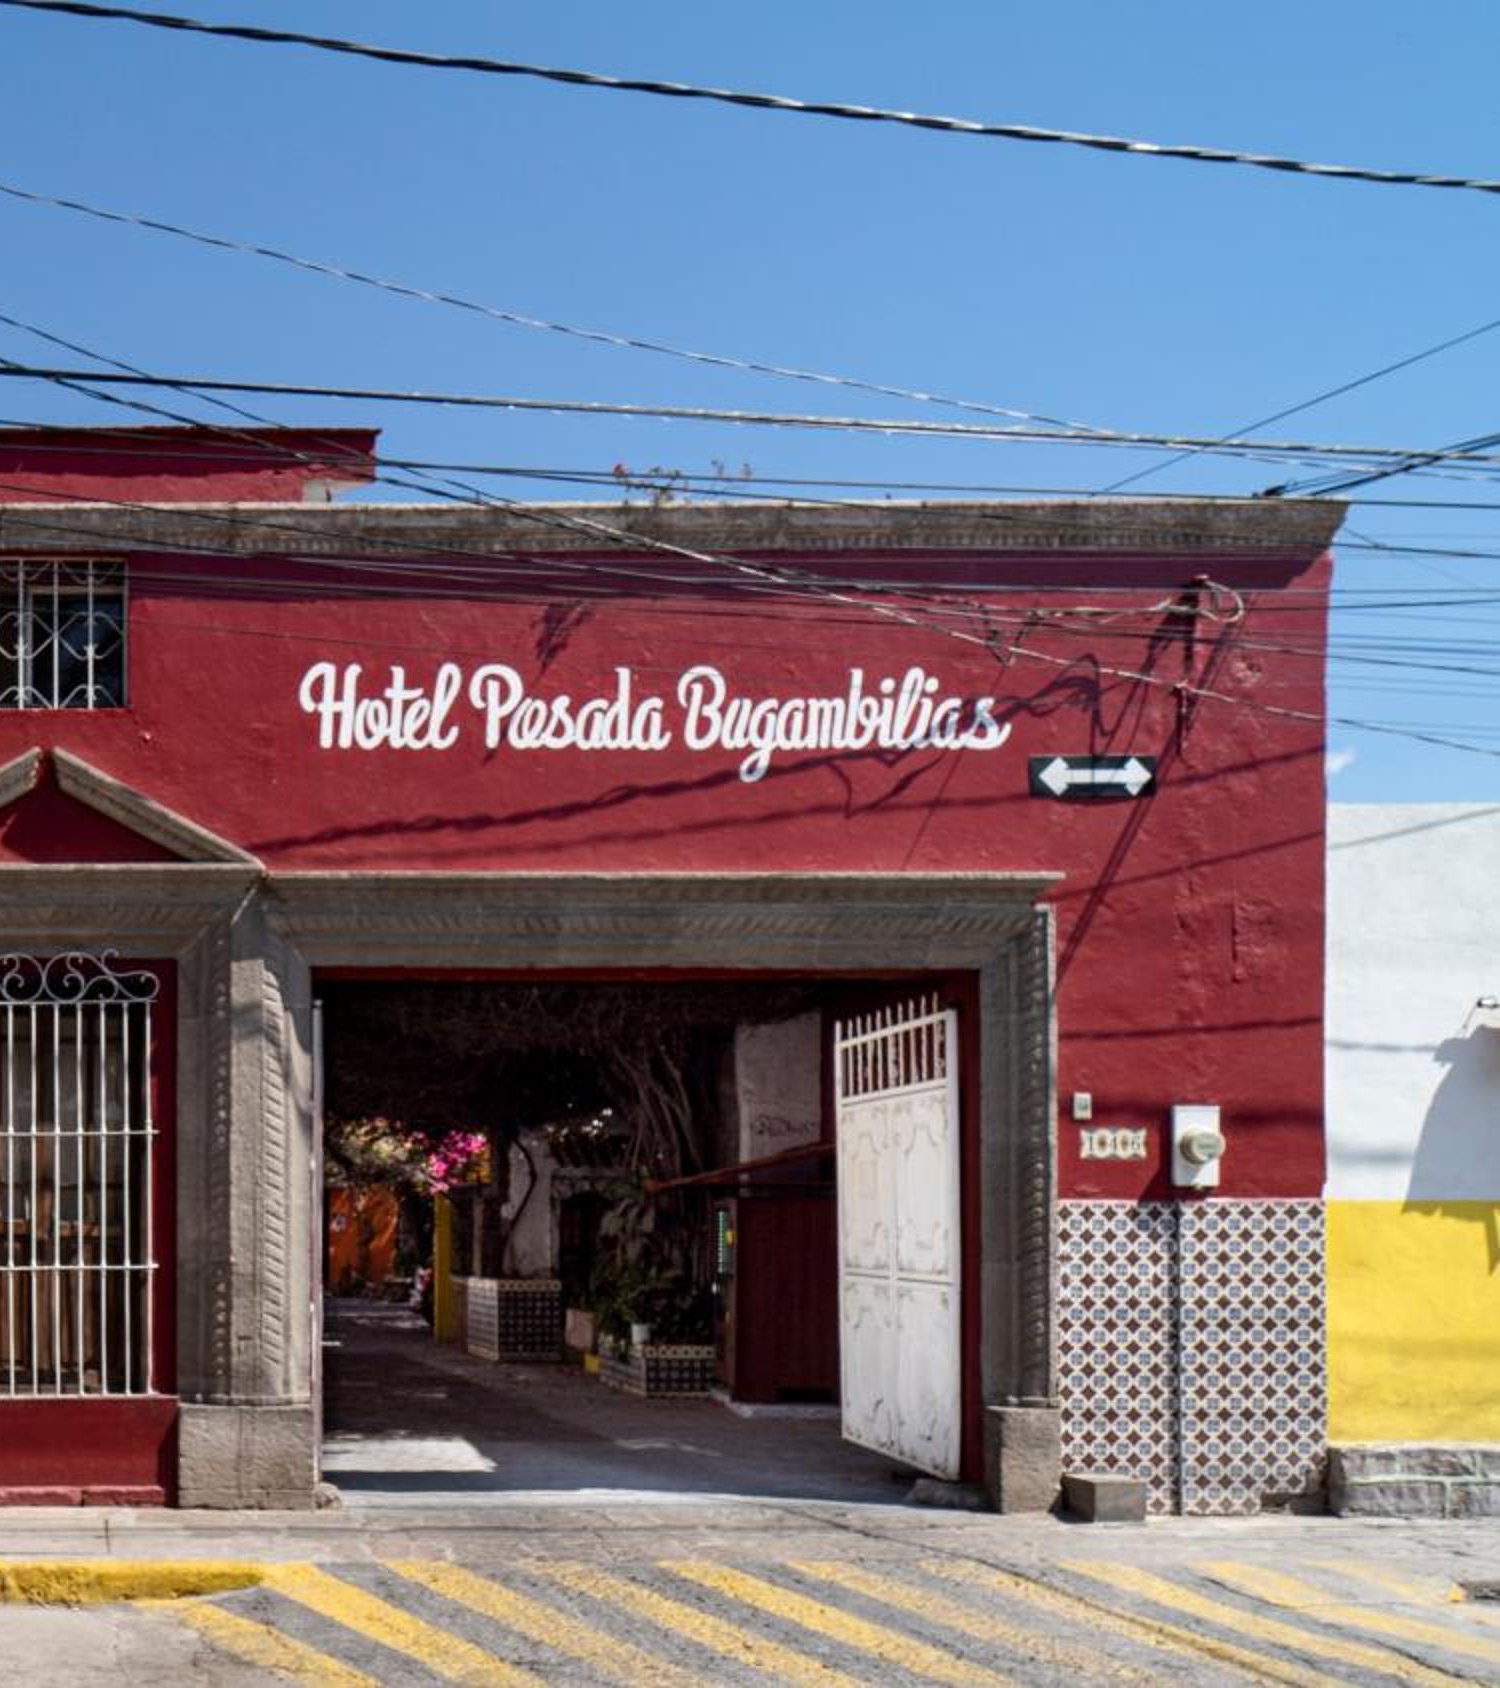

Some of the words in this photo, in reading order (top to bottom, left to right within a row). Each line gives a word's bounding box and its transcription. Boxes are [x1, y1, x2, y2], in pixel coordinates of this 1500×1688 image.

[299, 662, 460, 750] Hotel
[469, 664, 671, 750] Posada
[678, 664, 1011, 782] Bugambilias
